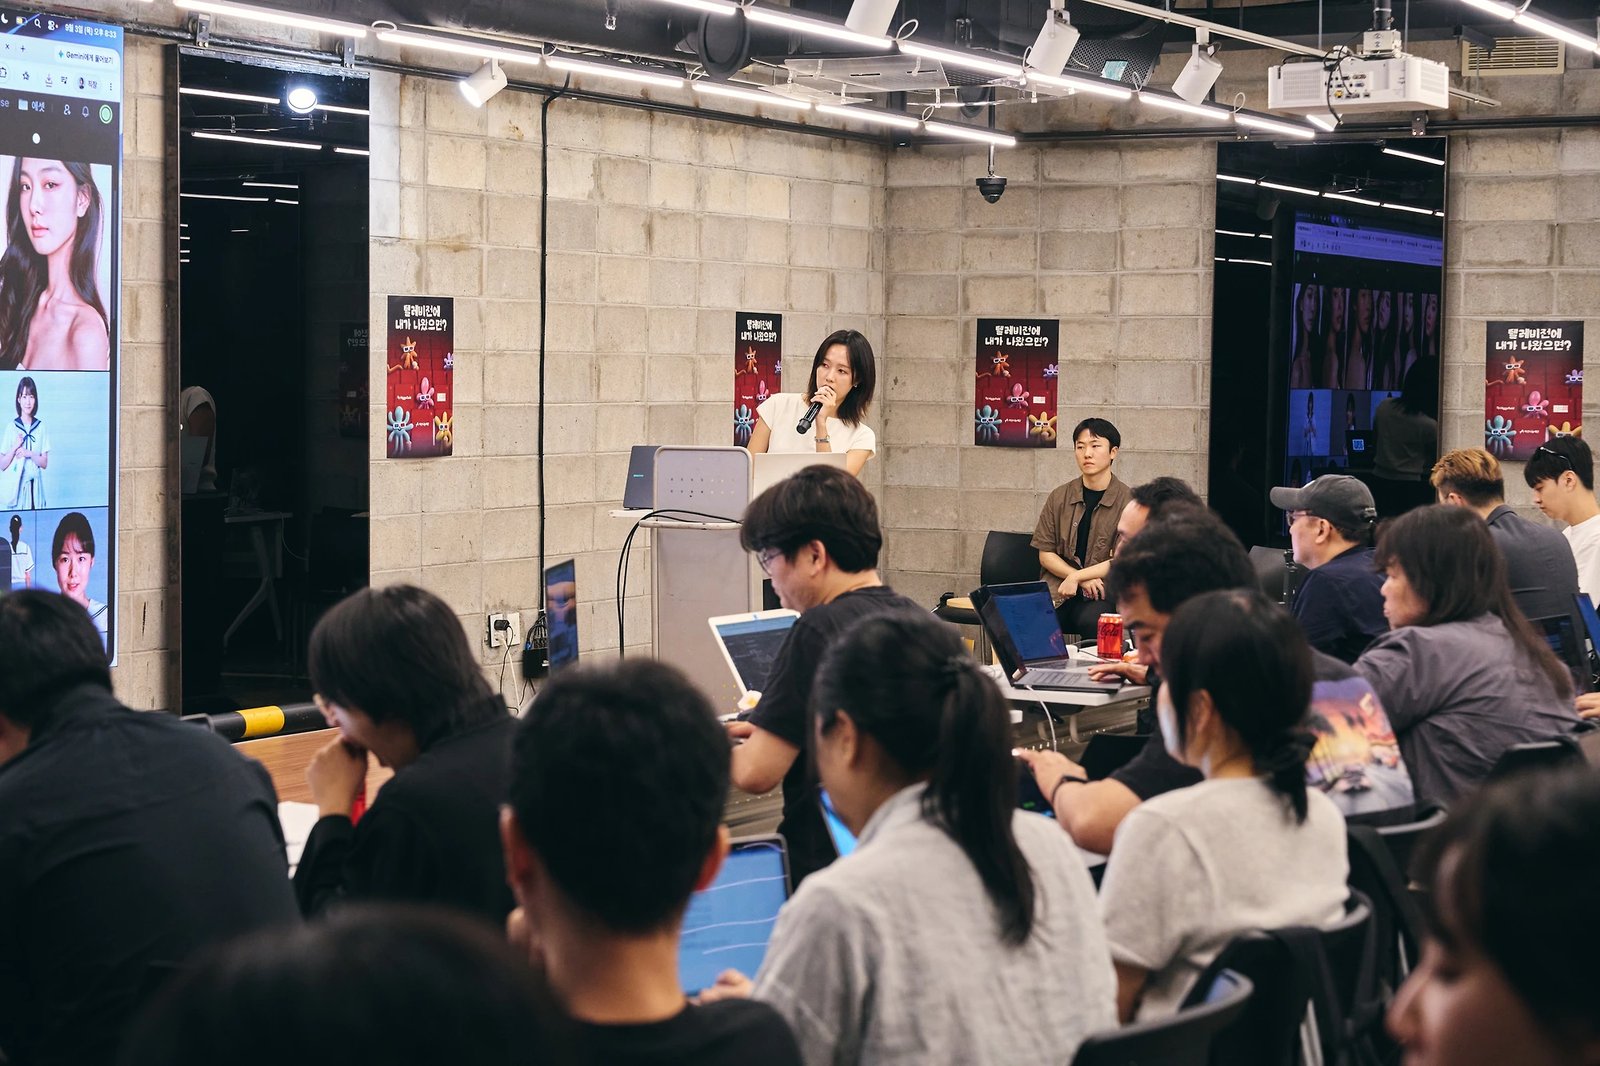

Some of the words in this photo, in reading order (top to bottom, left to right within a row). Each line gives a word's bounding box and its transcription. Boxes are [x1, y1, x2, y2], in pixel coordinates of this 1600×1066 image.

[65, 23, 74, 33] 9월
[75, 25, 83, 34] 3일
[84, 26, 93, 36] (목)
[94, 28, 103, 37] 오후
[104, 29, 117, 39] 8:33
[66, 51, 94, 62] Gemini에게
[95, 54, 114, 65] 물어보기
[403, 304, 441, 318] 텔레비전에
[395, 318, 412, 330] 내가
[413, 318, 448, 332] 나왔으면?
[995, 325, 1041, 336] 텔레비전에
[1507, 328, 1562, 339] 텔레비전에
[984, 336, 1004, 346] 내가
[1006, 336, 1049, 347] 나왔으면?
[1495, 340, 1518, 351] 내가
[1521, 340, 1572, 351] 나왔으면?
